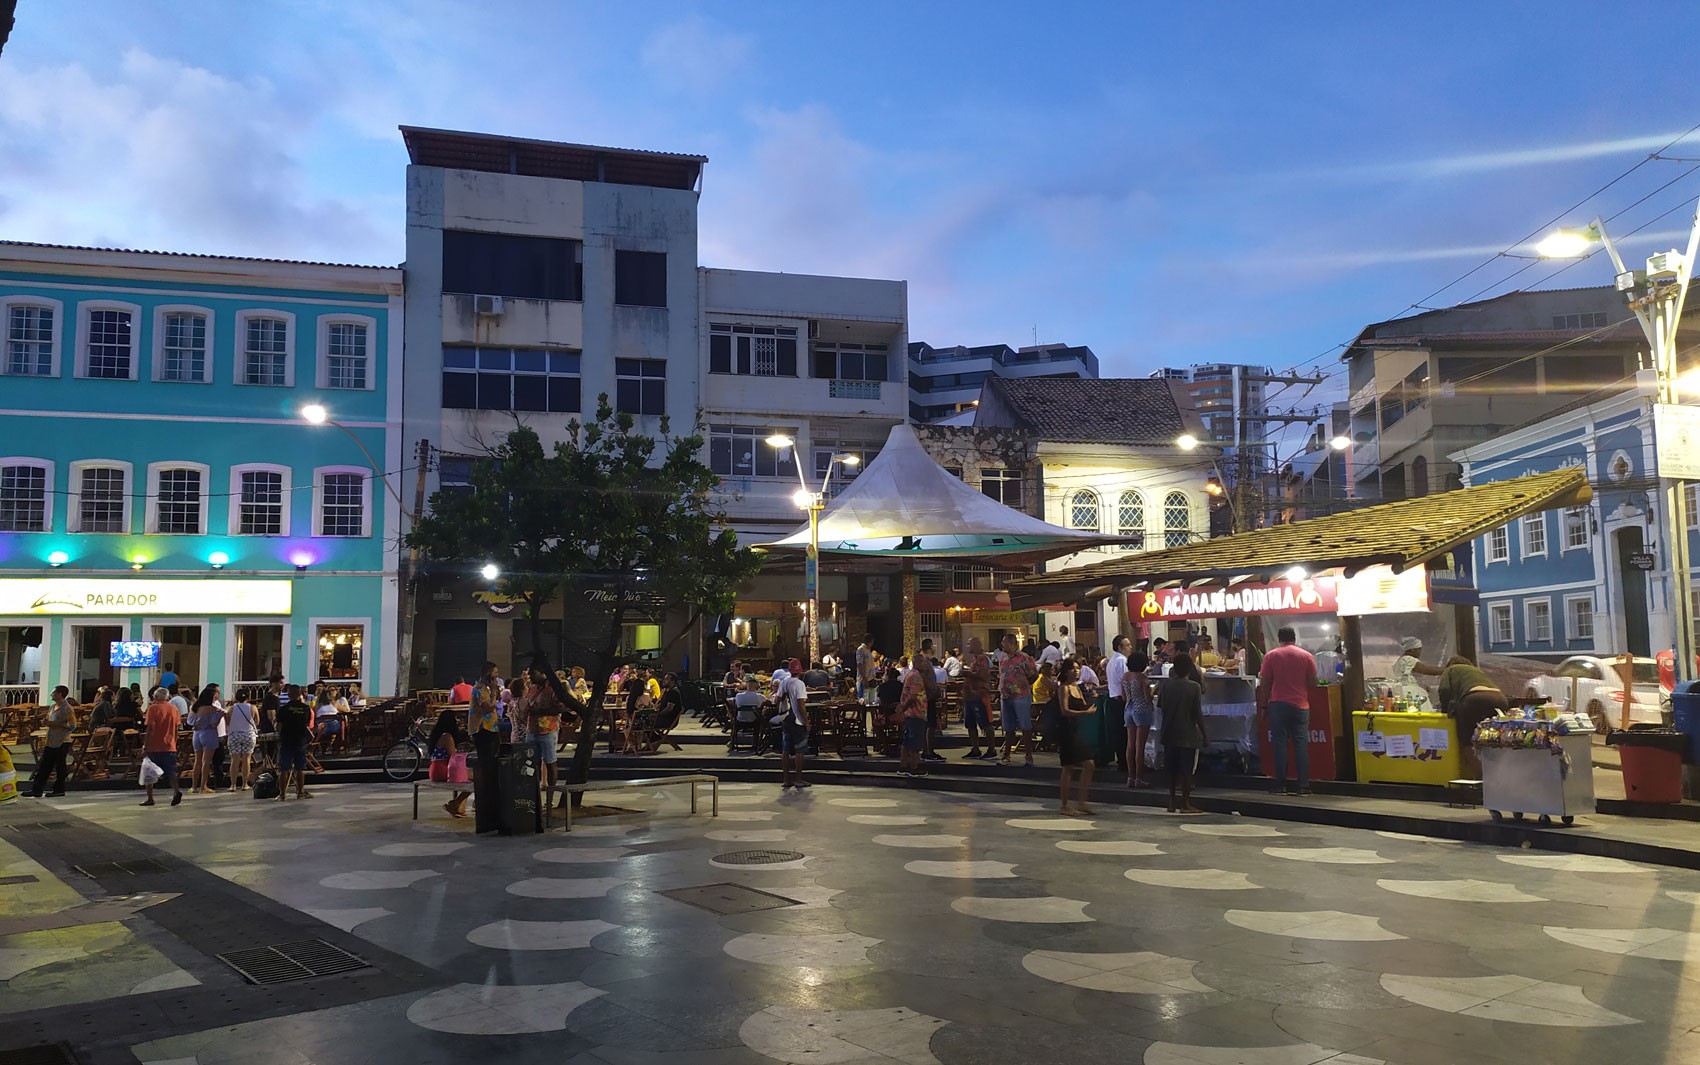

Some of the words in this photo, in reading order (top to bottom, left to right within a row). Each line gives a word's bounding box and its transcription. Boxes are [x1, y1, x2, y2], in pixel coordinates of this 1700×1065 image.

[86, 593, 157, 606] PARADOR
[1163, 588, 1225, 616] ACARAJÉ
[1226, 593, 1242, 610] DA
[1242, 586, 1295, 612] DINHA
